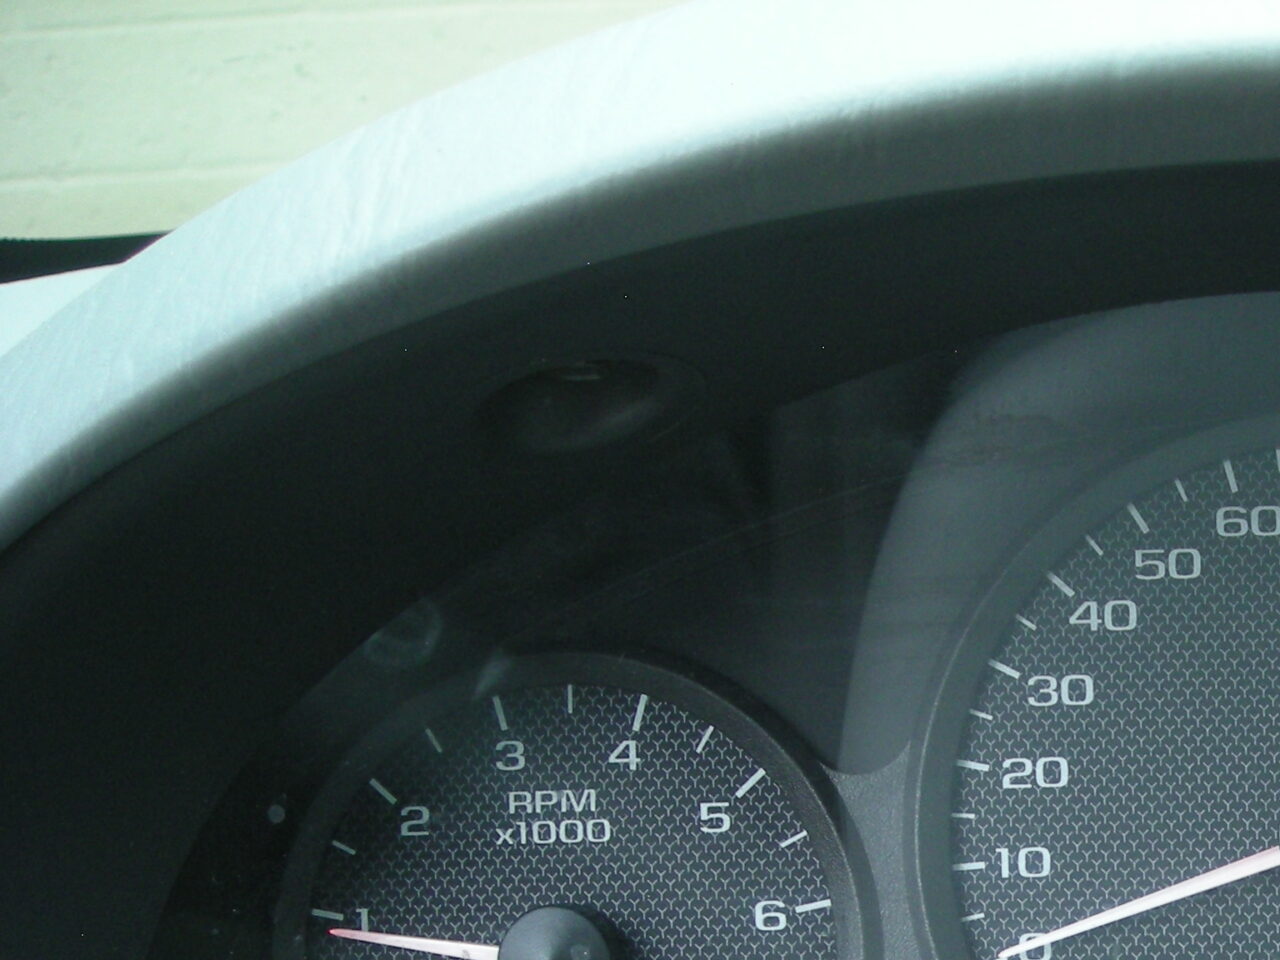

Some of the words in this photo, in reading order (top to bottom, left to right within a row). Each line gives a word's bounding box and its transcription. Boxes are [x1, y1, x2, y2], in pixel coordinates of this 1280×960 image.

[1134, 548, 1201, 580] 50
[1068, 600, 1137, 632] 40
[1027, 674, 1095, 706] 30
[495, 740, 526, 771] 3
[608, 740, 640, 771] 4
[1001, 756, 1069, 789] 20
[508, 788, 598, 814] RPM
[400, 806, 430, 836] 2
[496, 819, 612, 845] x1000
[699, 802, 732, 834] 5
[995, 846, 1051, 878] 10
[754, 900, 787, 931] 6
